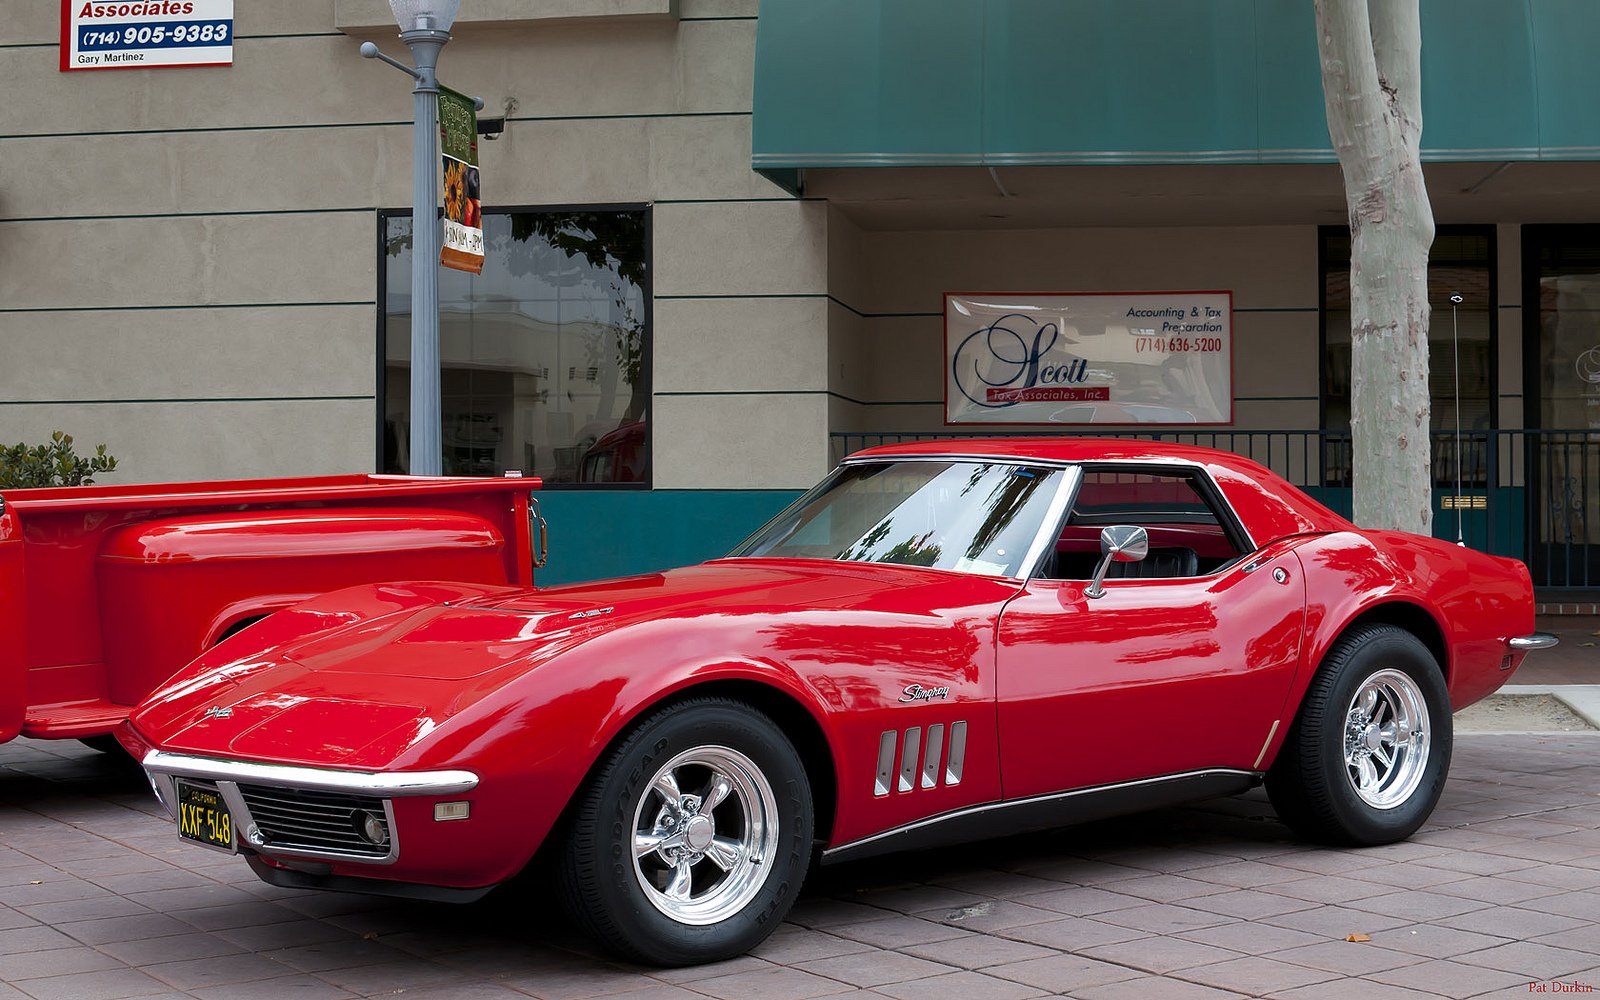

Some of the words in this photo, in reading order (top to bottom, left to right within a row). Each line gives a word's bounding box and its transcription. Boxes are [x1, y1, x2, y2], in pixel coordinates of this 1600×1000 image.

[78, 0, 194, 18] Associates
[83, 32, 121, 46] (714)
[123, 24, 228, 44] 905-9383
[78, 54, 100, 64] Gary
[104, 53, 144, 63] Martinez
[1126, 307, 1185, 320] Accounting
[1190, 306, 1199, 317] &
[1205, 307, 1222, 317] Tax
[1162, 322, 1222, 335] Preparation
[1136, 338, 1166, 353] (714)
[1169, 338, 1222, 352] 636-5200
[993, 389, 1011, 400] Tax
[1015, 388, 1079, 401] Associates,
[1084, 390, 1104, 399] Inc.
[898, 683, 950, 702] Stingray
[181, 802, 205, 837] XXF
[207, 809, 231, 844] 548
